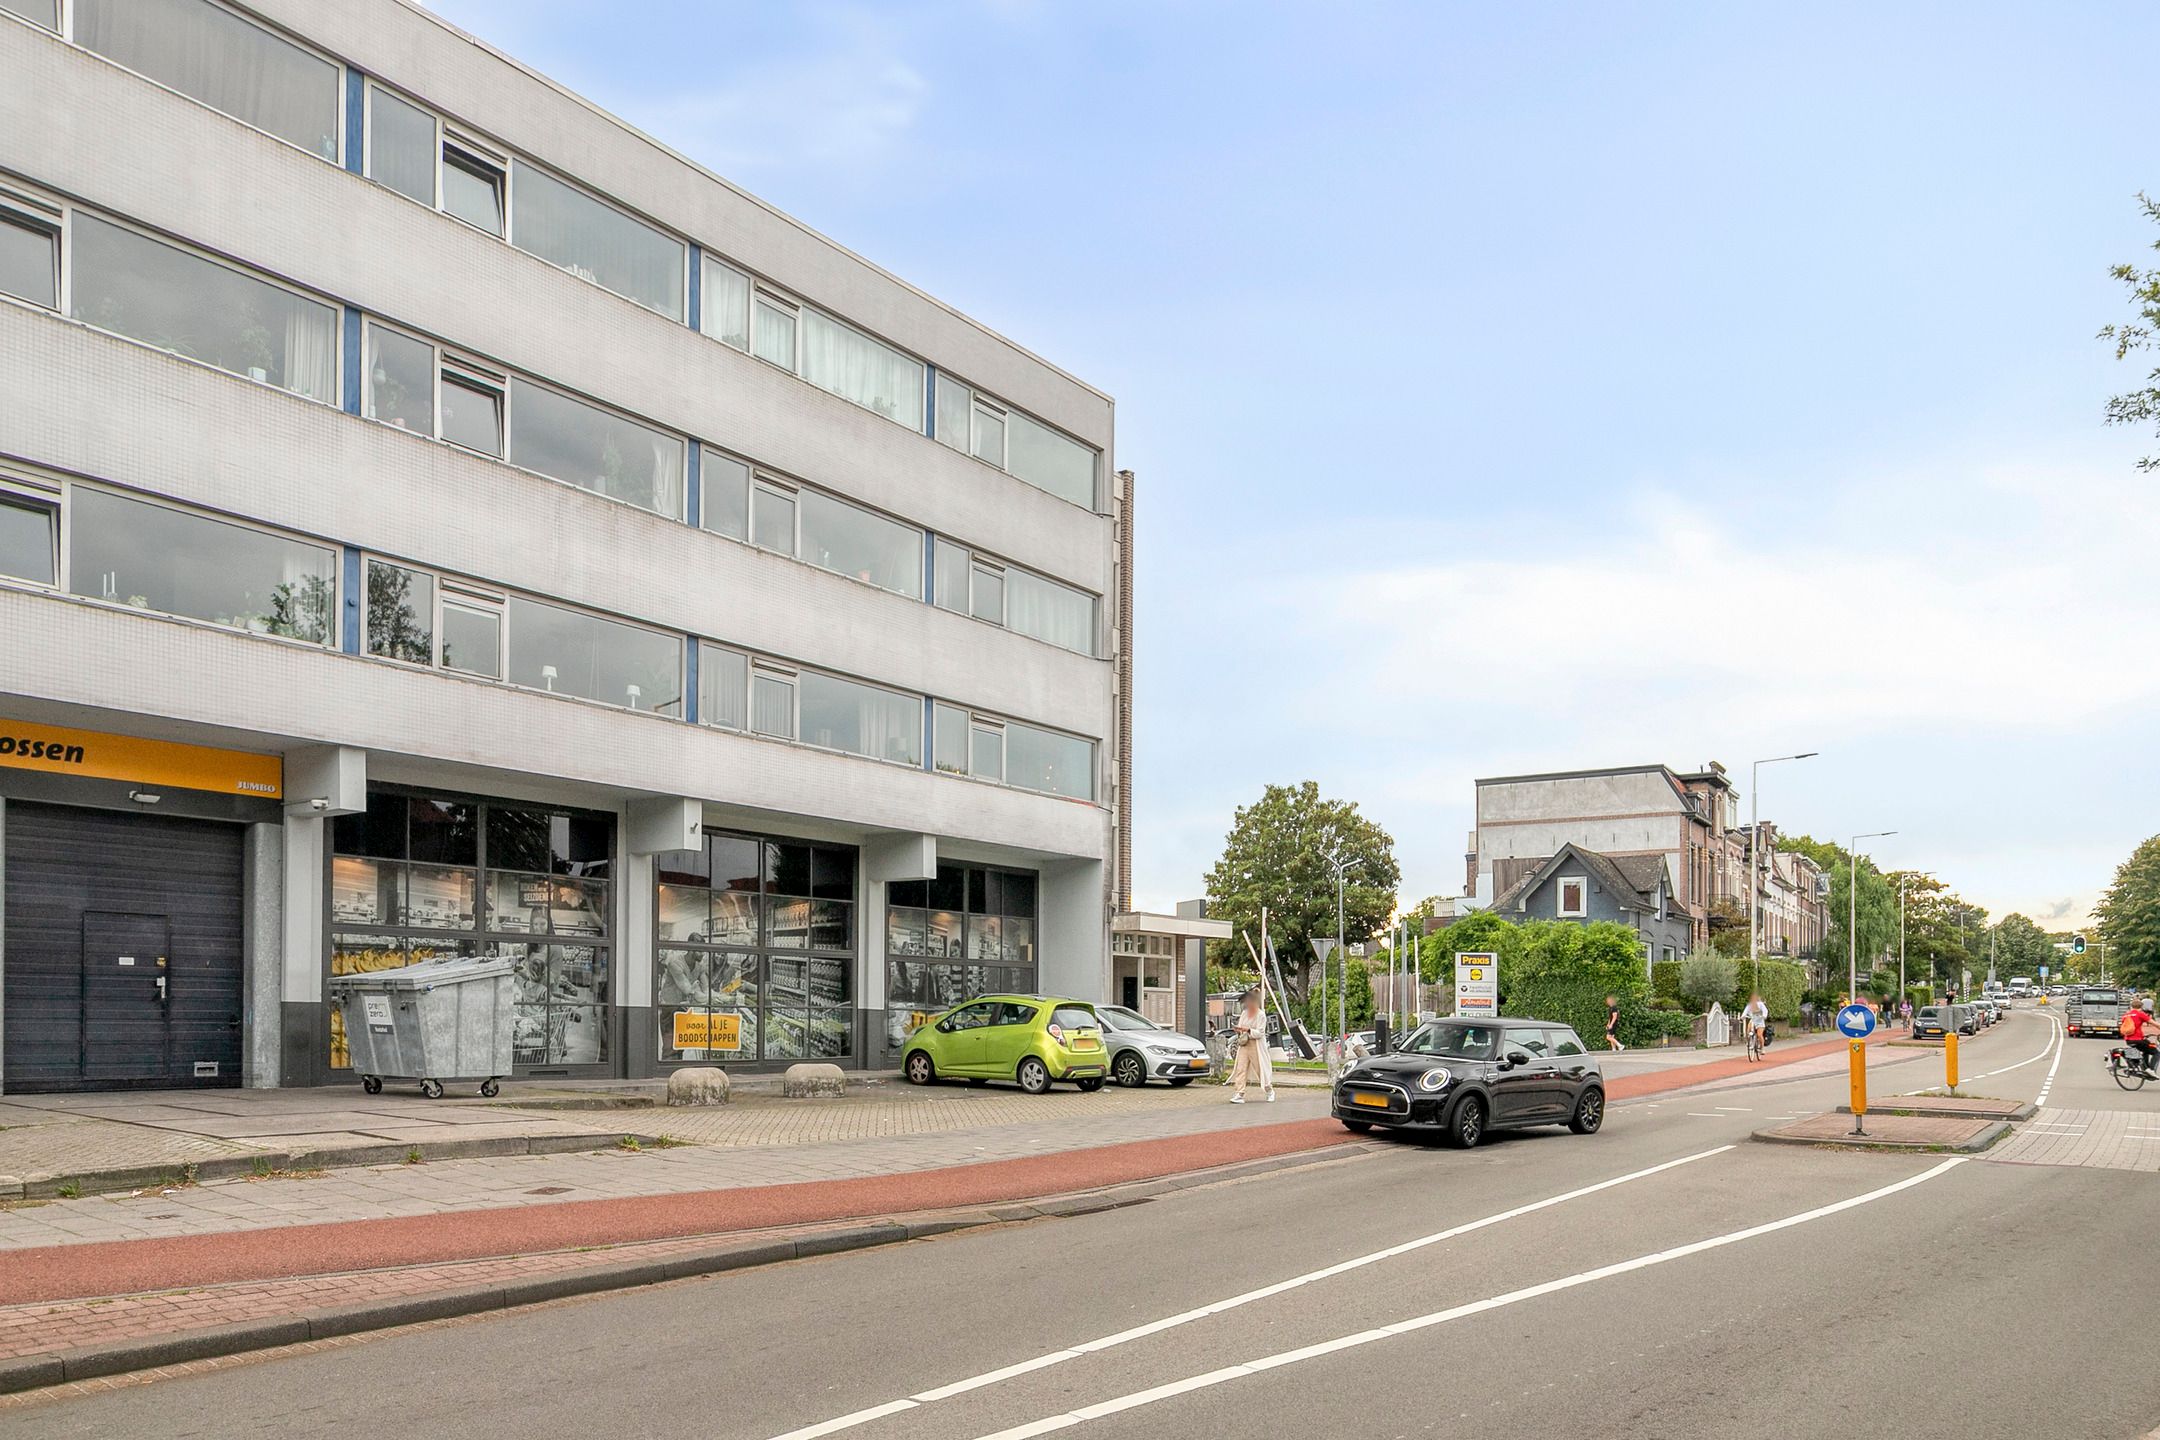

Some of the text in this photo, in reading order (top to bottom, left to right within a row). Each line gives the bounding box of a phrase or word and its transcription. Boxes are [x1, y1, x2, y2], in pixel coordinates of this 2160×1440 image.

[0, 736, 84, 763] ossen
[238, 781, 276, 793] JUMBO
[1462, 956, 1490, 965] Praxis
[686, 1022, 706, 1030] voor
[720, 1019, 728, 1031] JE
